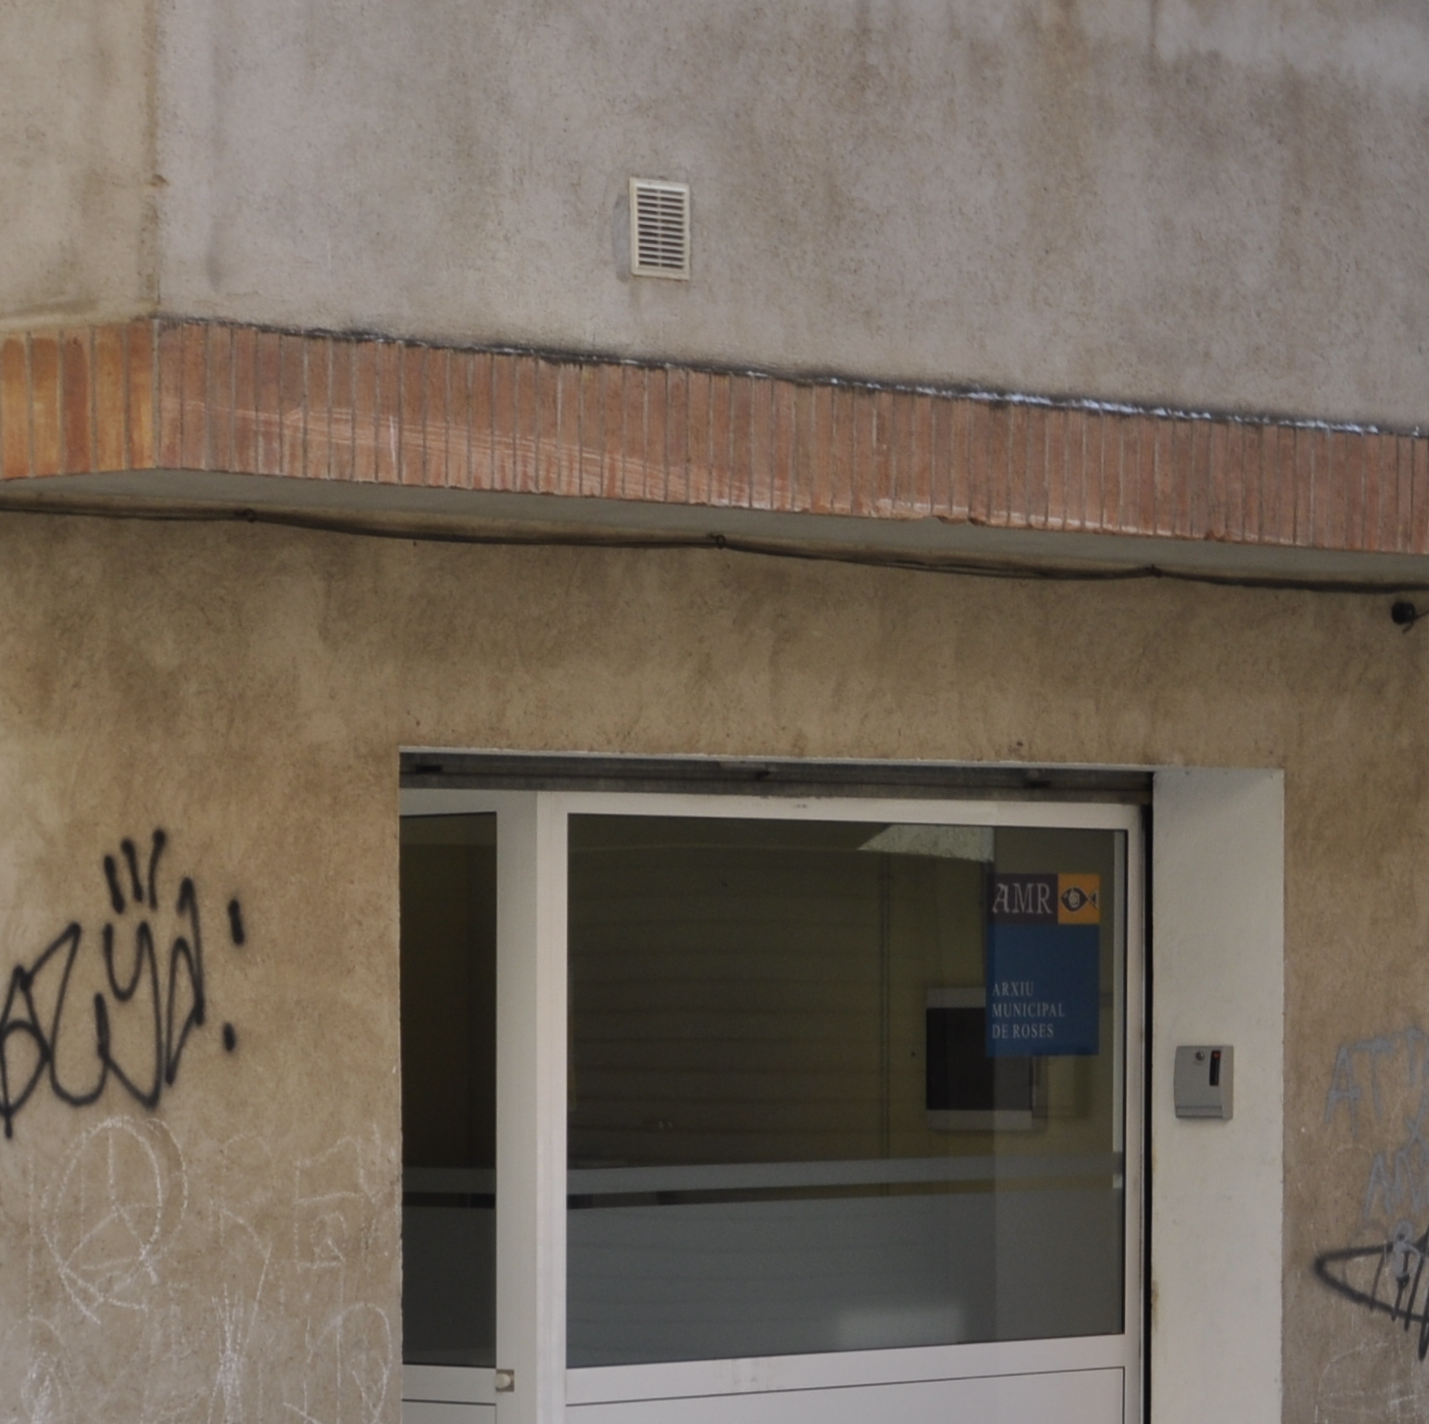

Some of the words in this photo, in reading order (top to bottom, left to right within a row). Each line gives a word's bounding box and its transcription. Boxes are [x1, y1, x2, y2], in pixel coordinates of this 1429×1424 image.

[991, 883, 1053, 915] AMR
[991, 981, 1035, 997] ARXIU
[991, 1002, 1066, 1018] MUNICIPAL
[992, 1023, 1009, 1039] DE
[1012, 1023, 1055, 1039] ROSES
